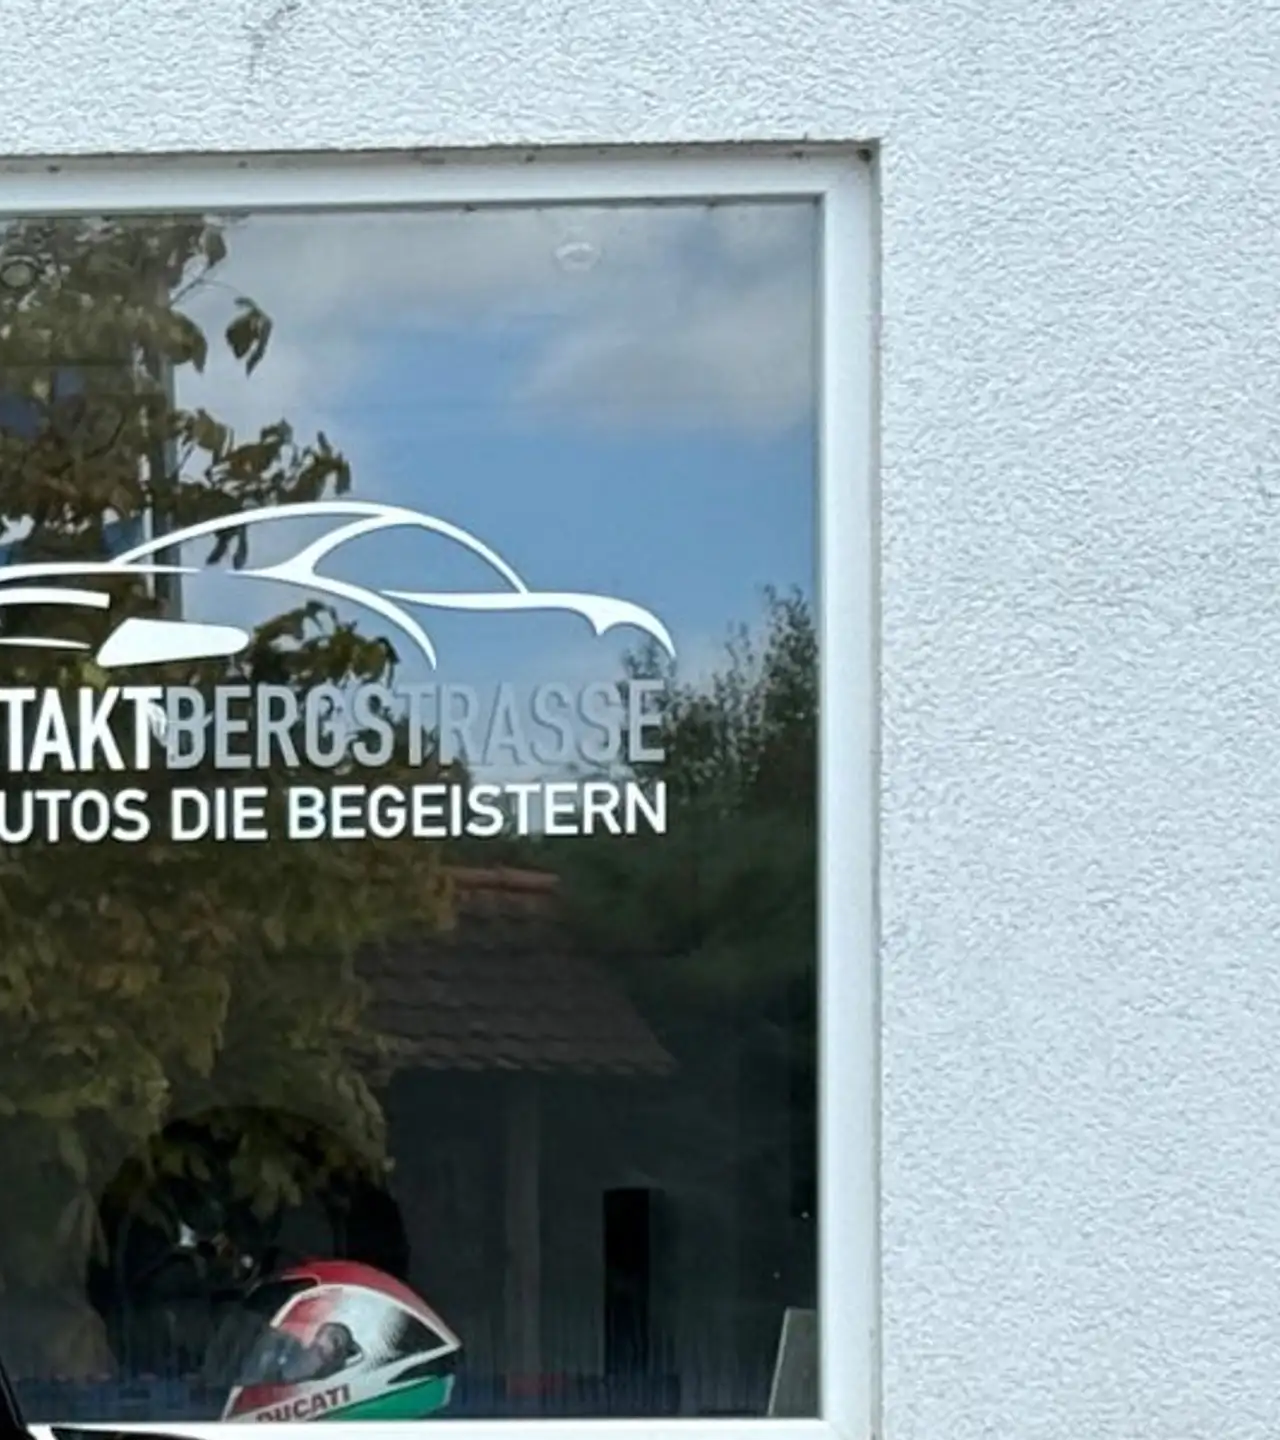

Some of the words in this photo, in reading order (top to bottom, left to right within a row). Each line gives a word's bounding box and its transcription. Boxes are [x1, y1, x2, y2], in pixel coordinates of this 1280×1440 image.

[170, 787, 268, 841] DIE
[288, 782, 667, 838] BEGEISTERN
[256, 1383, 350, 1422] DUCATI
